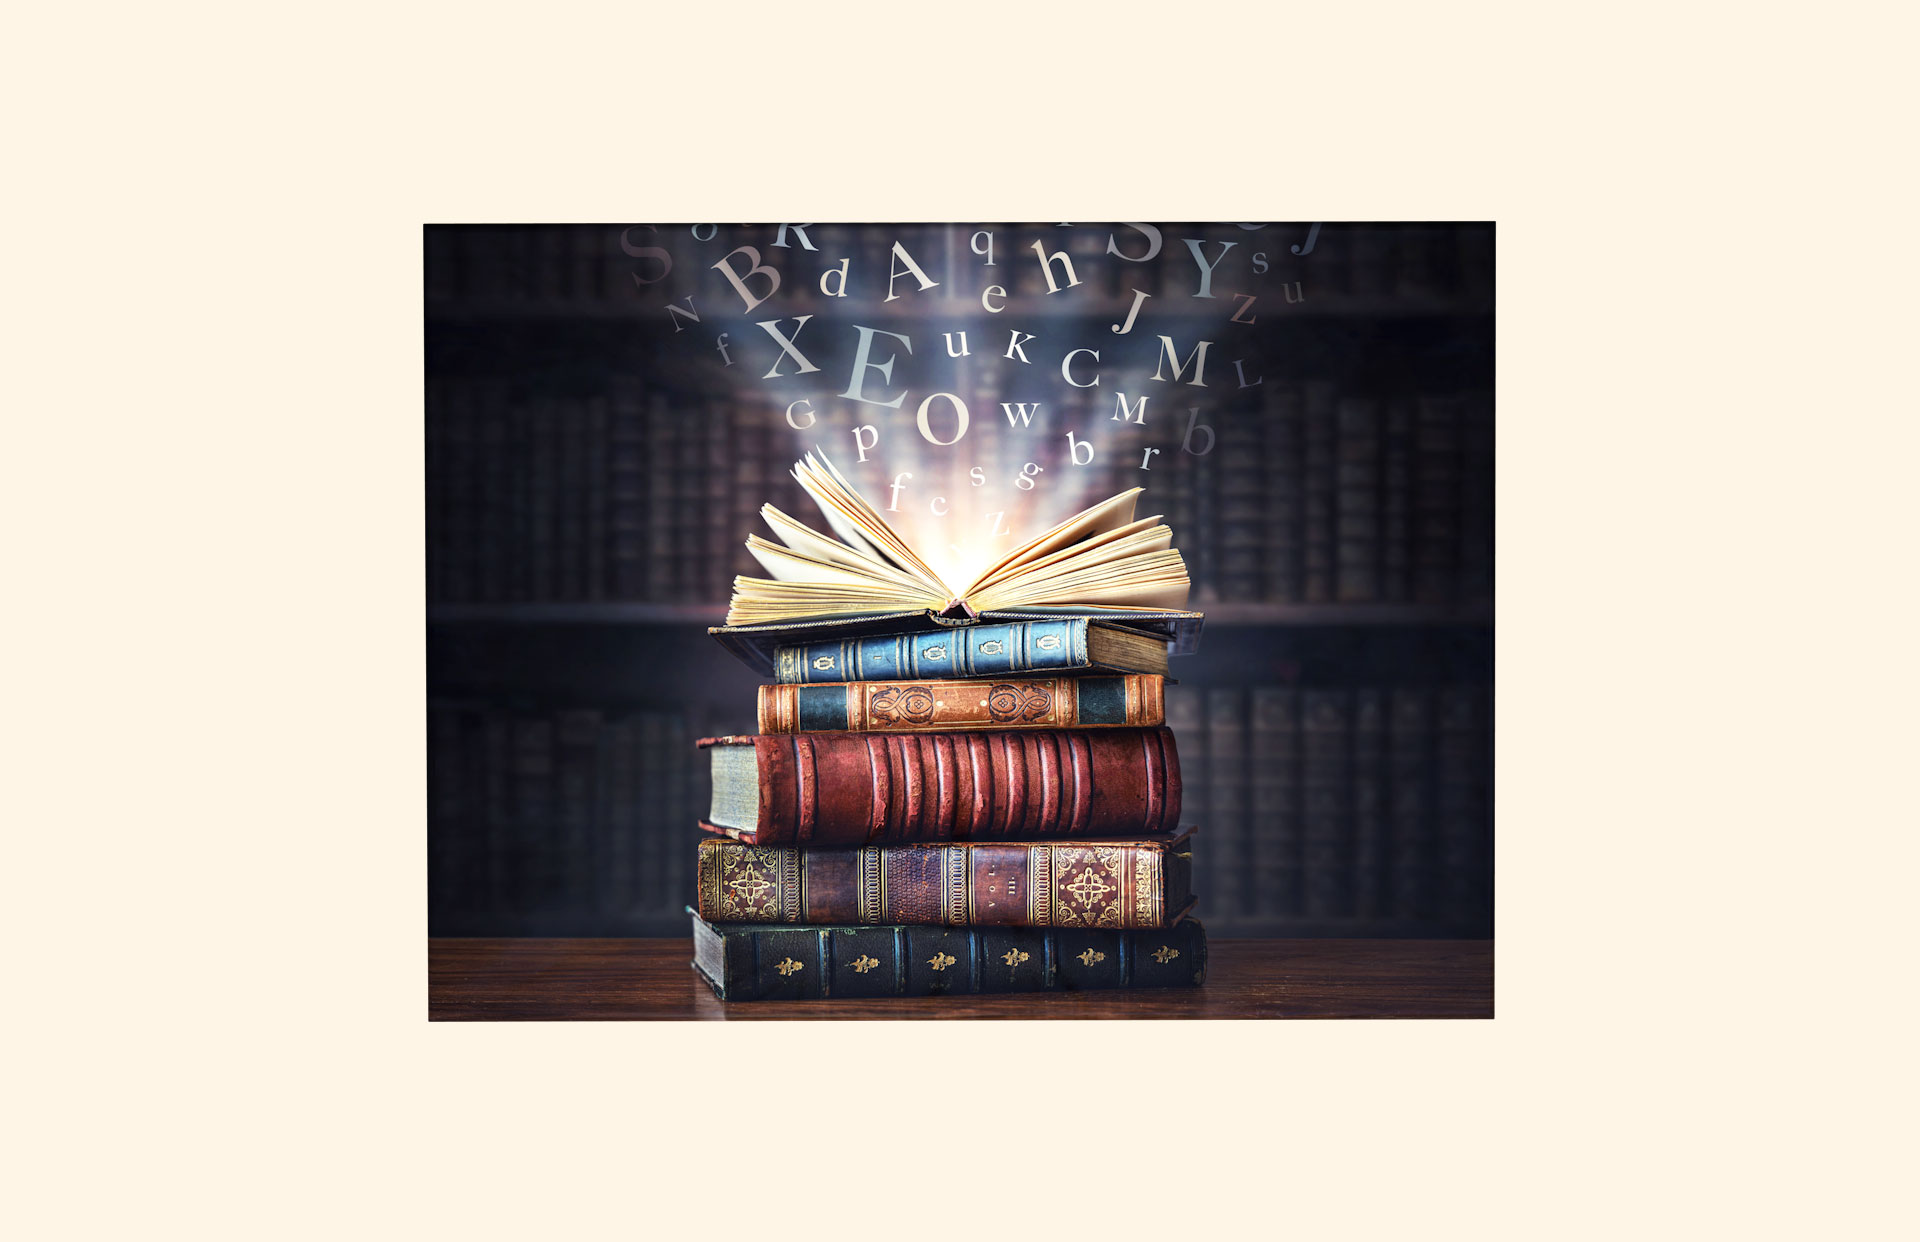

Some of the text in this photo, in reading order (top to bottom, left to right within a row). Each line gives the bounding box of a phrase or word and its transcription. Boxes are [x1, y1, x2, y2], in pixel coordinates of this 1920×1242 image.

[970, 230, 997, 266] q
[1031, 239, 1082, 295] h
[711, 245, 781, 314] B
[820, 258, 849, 297] d
[884, 241, 940, 302] A
[1182, 238, 1238, 298] Y
[664, 296, 700, 333] N
[982, 284, 1007, 313] e
[1111, 288, 1151, 335] J
[717, 333, 735, 367] f
[756, 315, 821, 379] X
[942, 331, 971, 357] u
[1150, 335, 1213, 387] M
[837, 325, 913, 409] E
[1061, 348, 1100, 388] C
[1232, 358, 1262, 389] L
[786, 399, 816, 430] G
[1110, 392, 1149, 425] M
[852, 424, 878, 462] p
[1066, 430, 1094, 467] b
[1181, 407, 1216, 456] b
[1015, 462, 1043, 491] g
[1139, 447, 1160, 471] r
[886, 472, 913, 512] f
